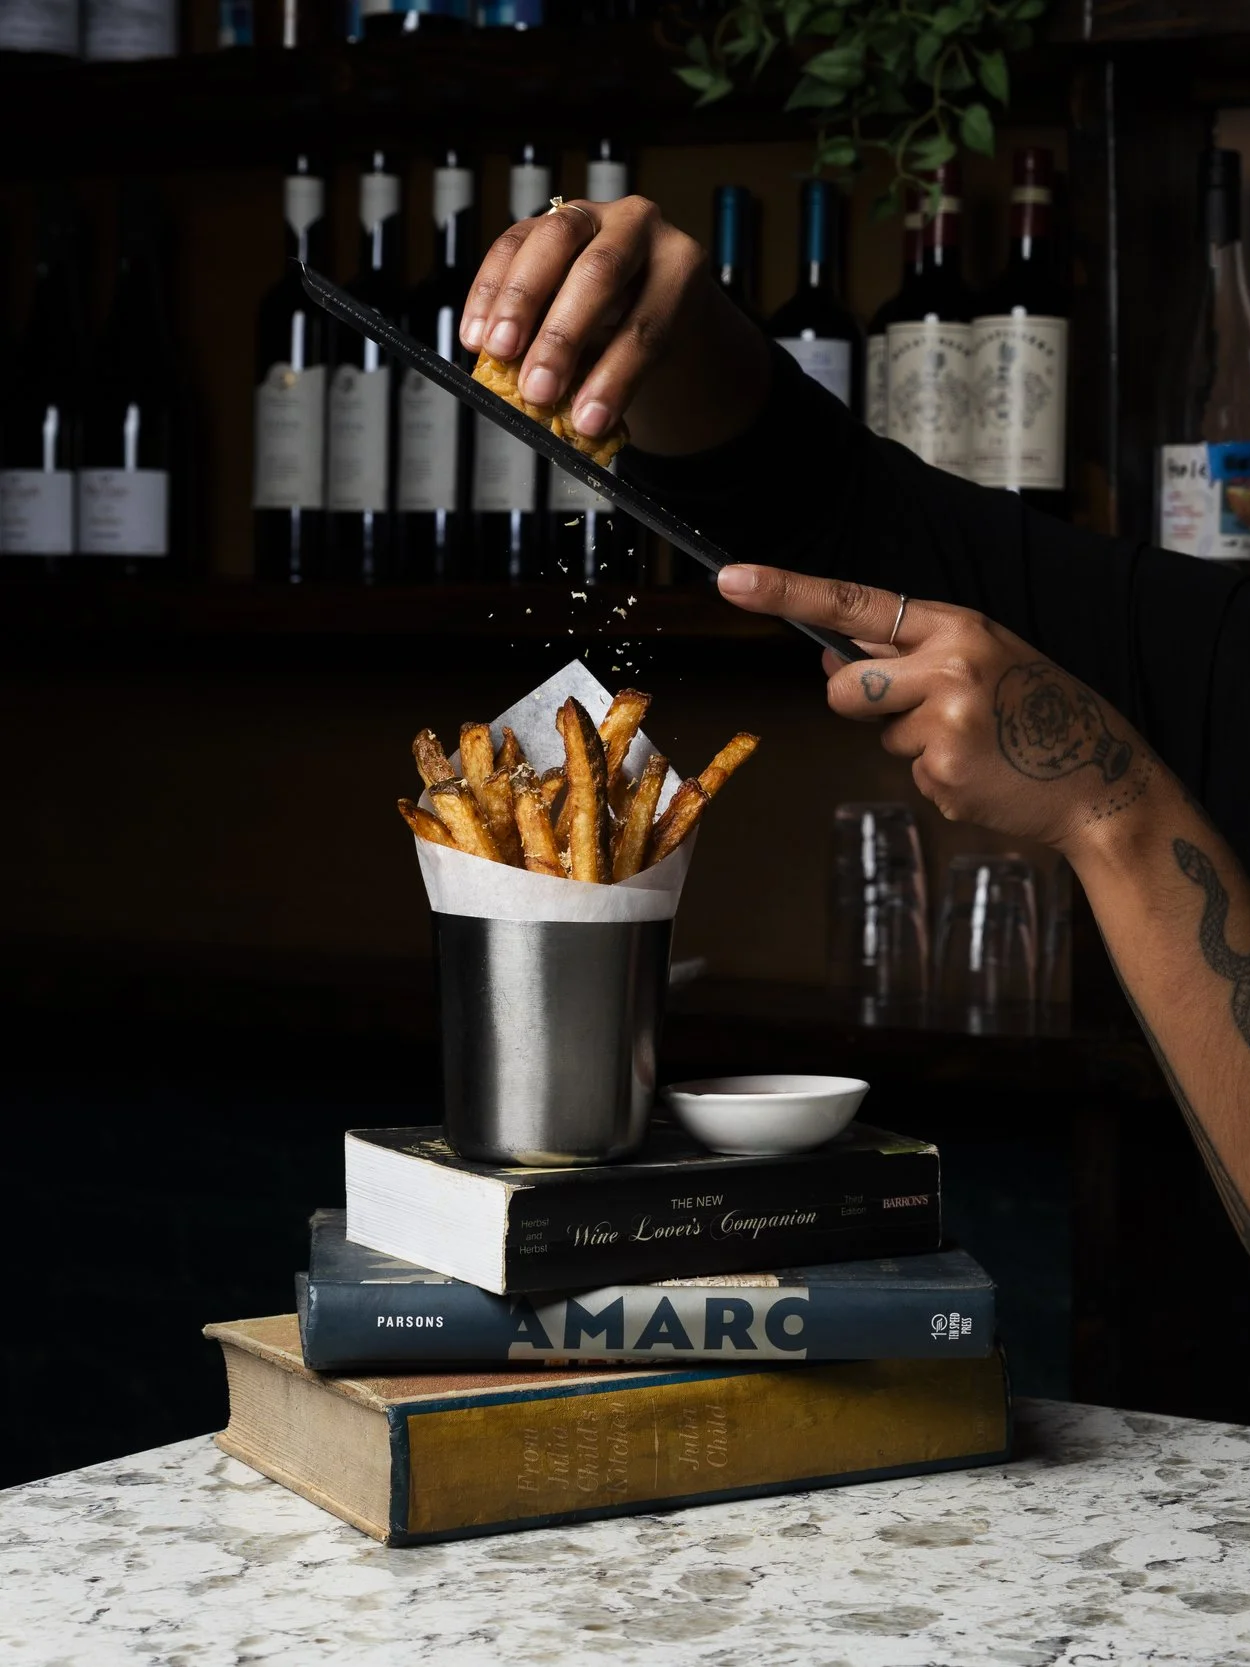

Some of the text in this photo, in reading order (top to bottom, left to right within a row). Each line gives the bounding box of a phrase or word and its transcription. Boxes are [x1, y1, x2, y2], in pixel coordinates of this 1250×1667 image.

[671, 1194, 724, 1210] THE NEW
[844, 1194, 864, 1204] Third
[883, 1194, 929, 1209] BARRON'S
[841, 1206, 866, 1216] Edition
[521, 1217, 549, 1229] Herbst
[566, 1208, 817, 1248] Wine Lover's Companion
[525, 1231, 543, 1242] and
[519, 1243, 549, 1255] Herbst
[377, 1316, 445, 1329] PARSONS
[948, 1312, 960, 1340] TEN SPEED
[961, 1317, 972, 1335] PRESS
[678, 1408, 699, 1471] Julia
[705, 1403, 728, 1468] Child
[577, 1409, 600, 1492] Child's
[606, 1402, 628, 1494] Kitchen
[517, 1427, 540, 1493] From
[547, 1426, 569, 1490] Julia
